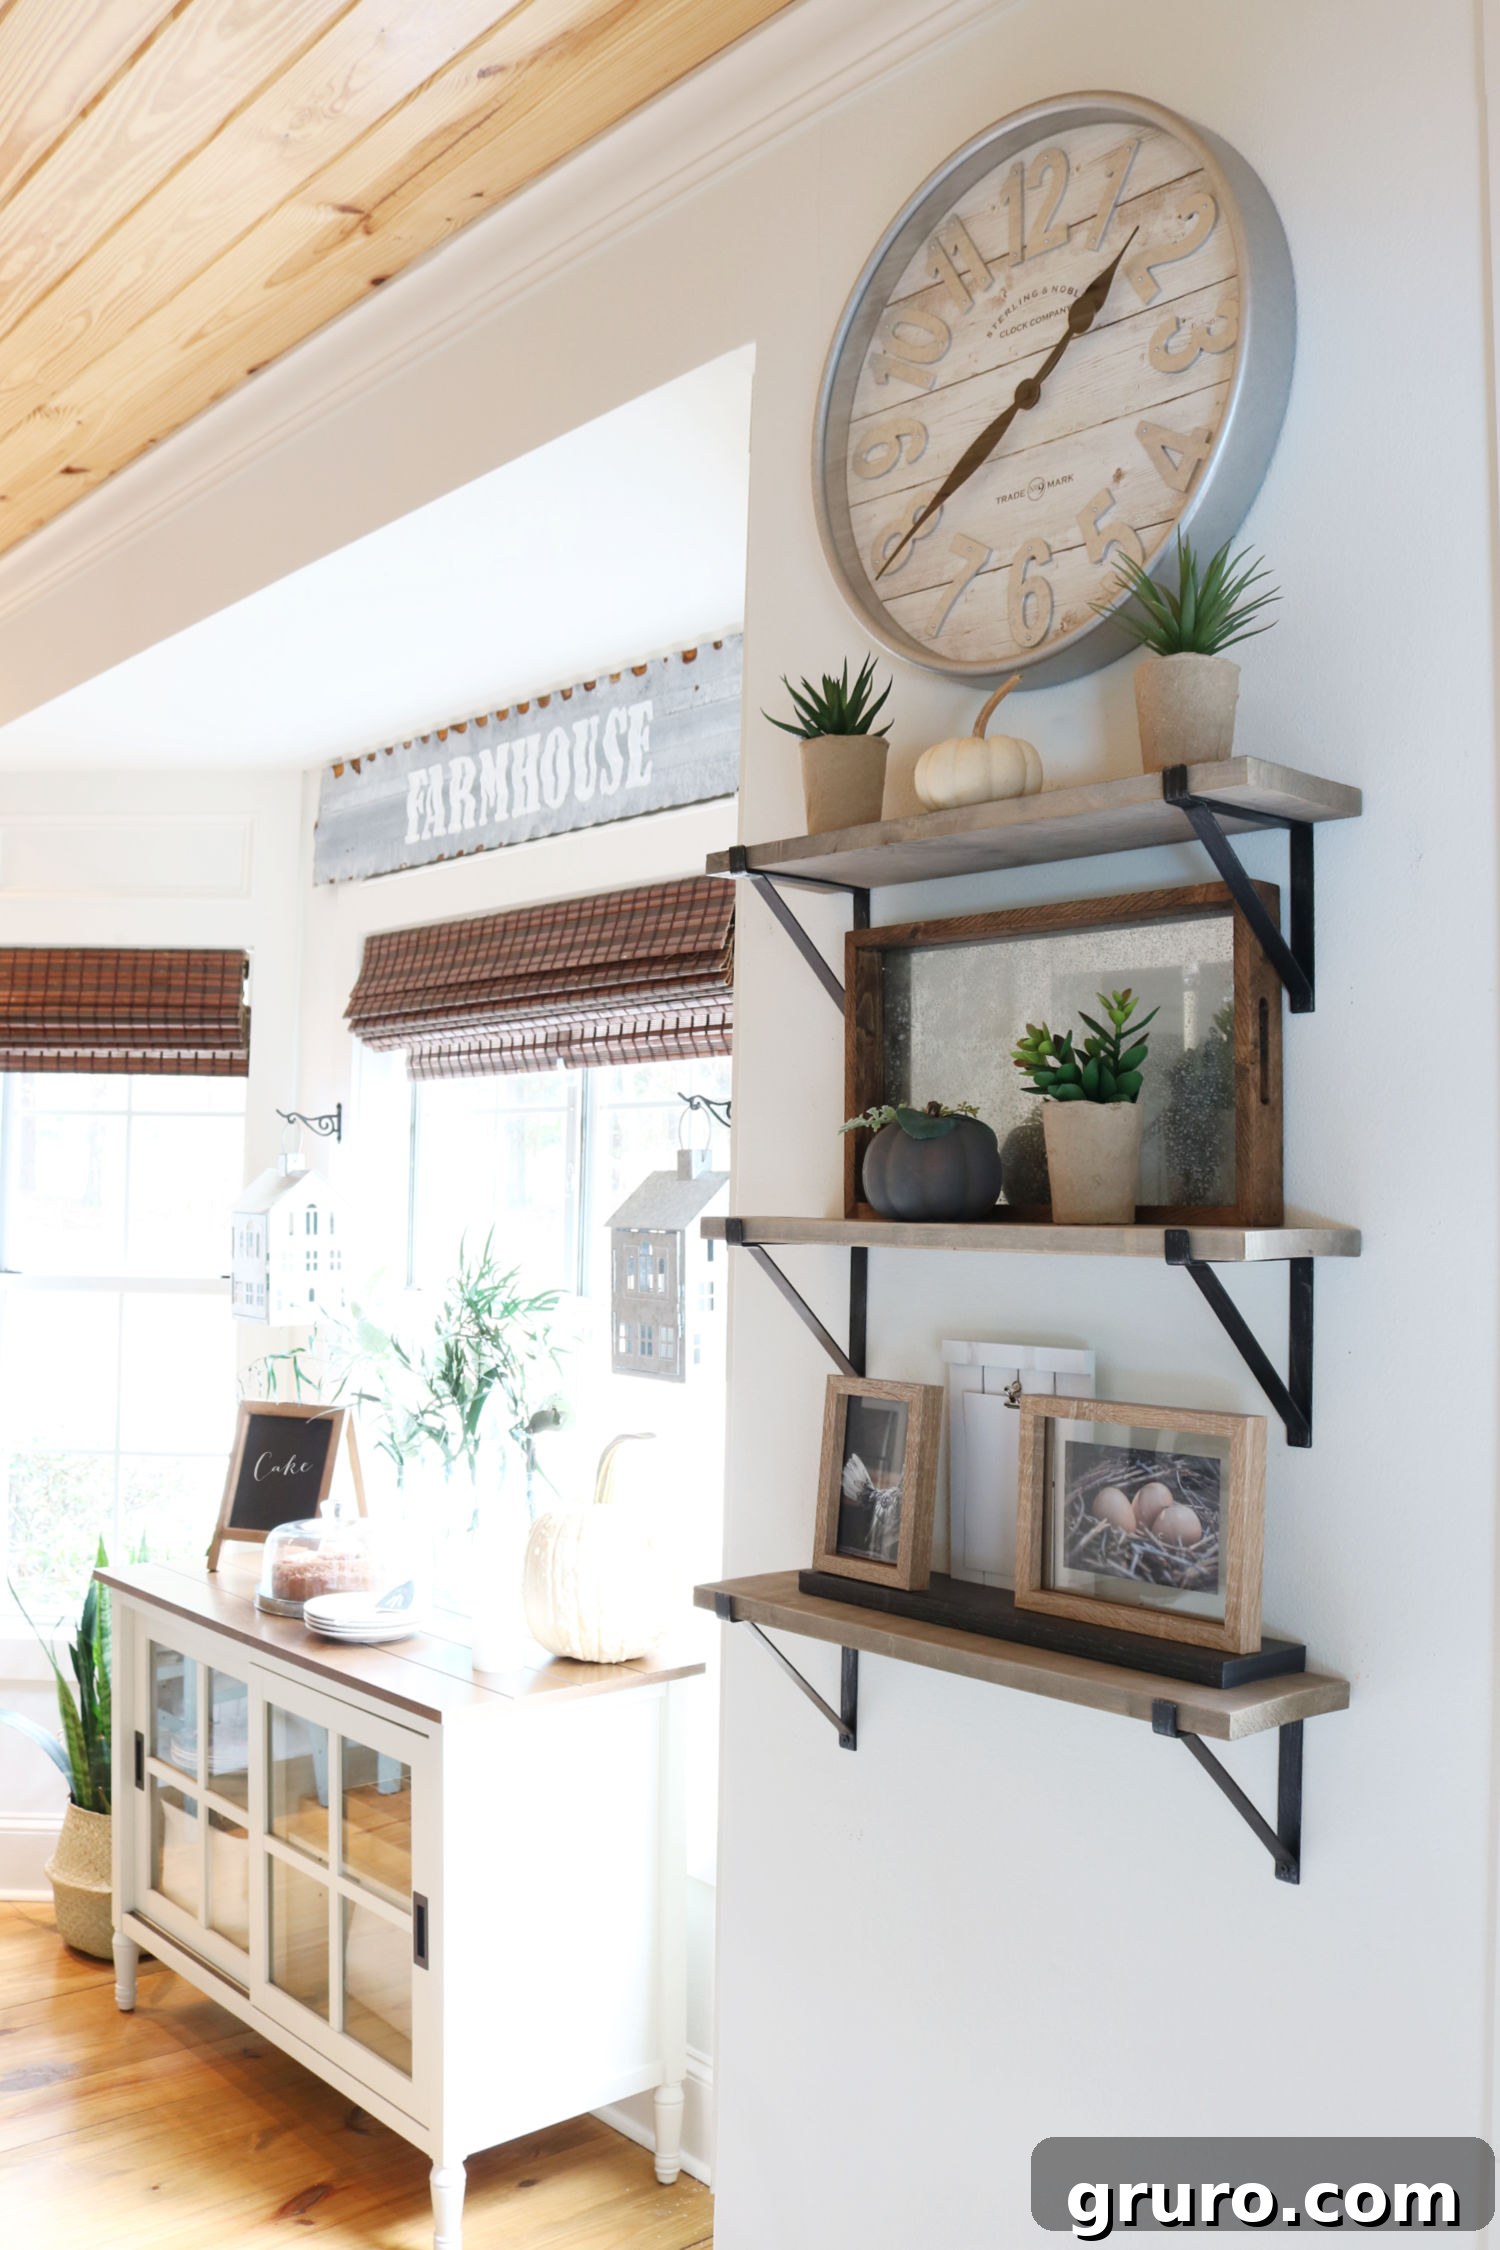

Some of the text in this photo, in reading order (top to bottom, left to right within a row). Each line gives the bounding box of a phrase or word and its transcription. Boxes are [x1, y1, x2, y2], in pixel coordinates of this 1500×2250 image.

[1000, 147, 1069, 267] 12
[1123, 192, 1219, 305] 2
[925, 214, 994, 314] 11
[868, 308, 951, 390] 10
[987, 290, 1038, 338] STERLING
[1051, 285, 1079, 298] NOBL
[999, 322, 1028, 338] CLOCK
[1149, 297, 1238, 374] 3
[853, 419, 928, 480] 9
[996, 474, 1074, 504] TRADE MARK
[1135, 421, 1212, 493] 4
[871, 491, 944, 576] 8
[1076, 487, 1146, 592] 5
[924, 533, 992, 638] 7
[1008, 537, 1054, 648] 6
[405, 701, 653, 844] FARMHOUSE
[254, 1452, 314, 1482] Cake
